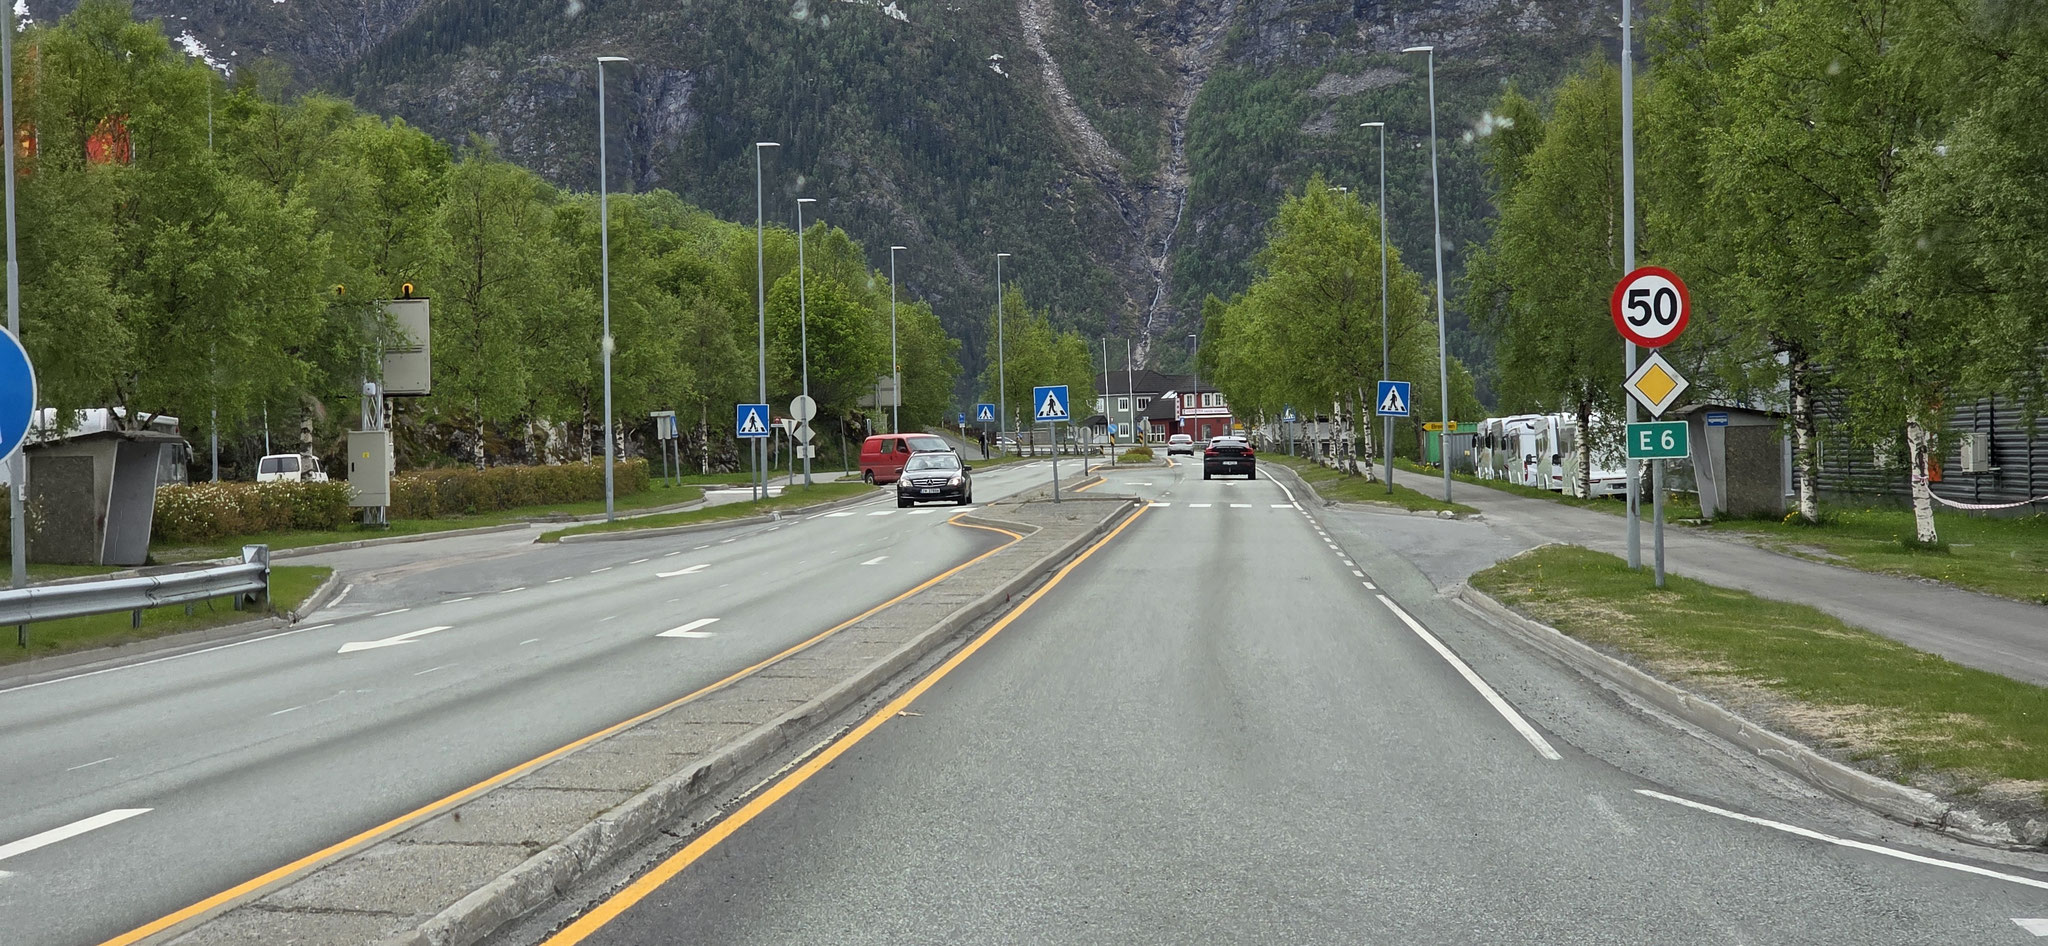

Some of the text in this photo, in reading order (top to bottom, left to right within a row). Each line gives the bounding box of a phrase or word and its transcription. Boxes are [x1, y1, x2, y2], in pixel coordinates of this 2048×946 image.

[1628, 288, 1677, 326] 50
[1640, 430, 1674, 450] E 6
